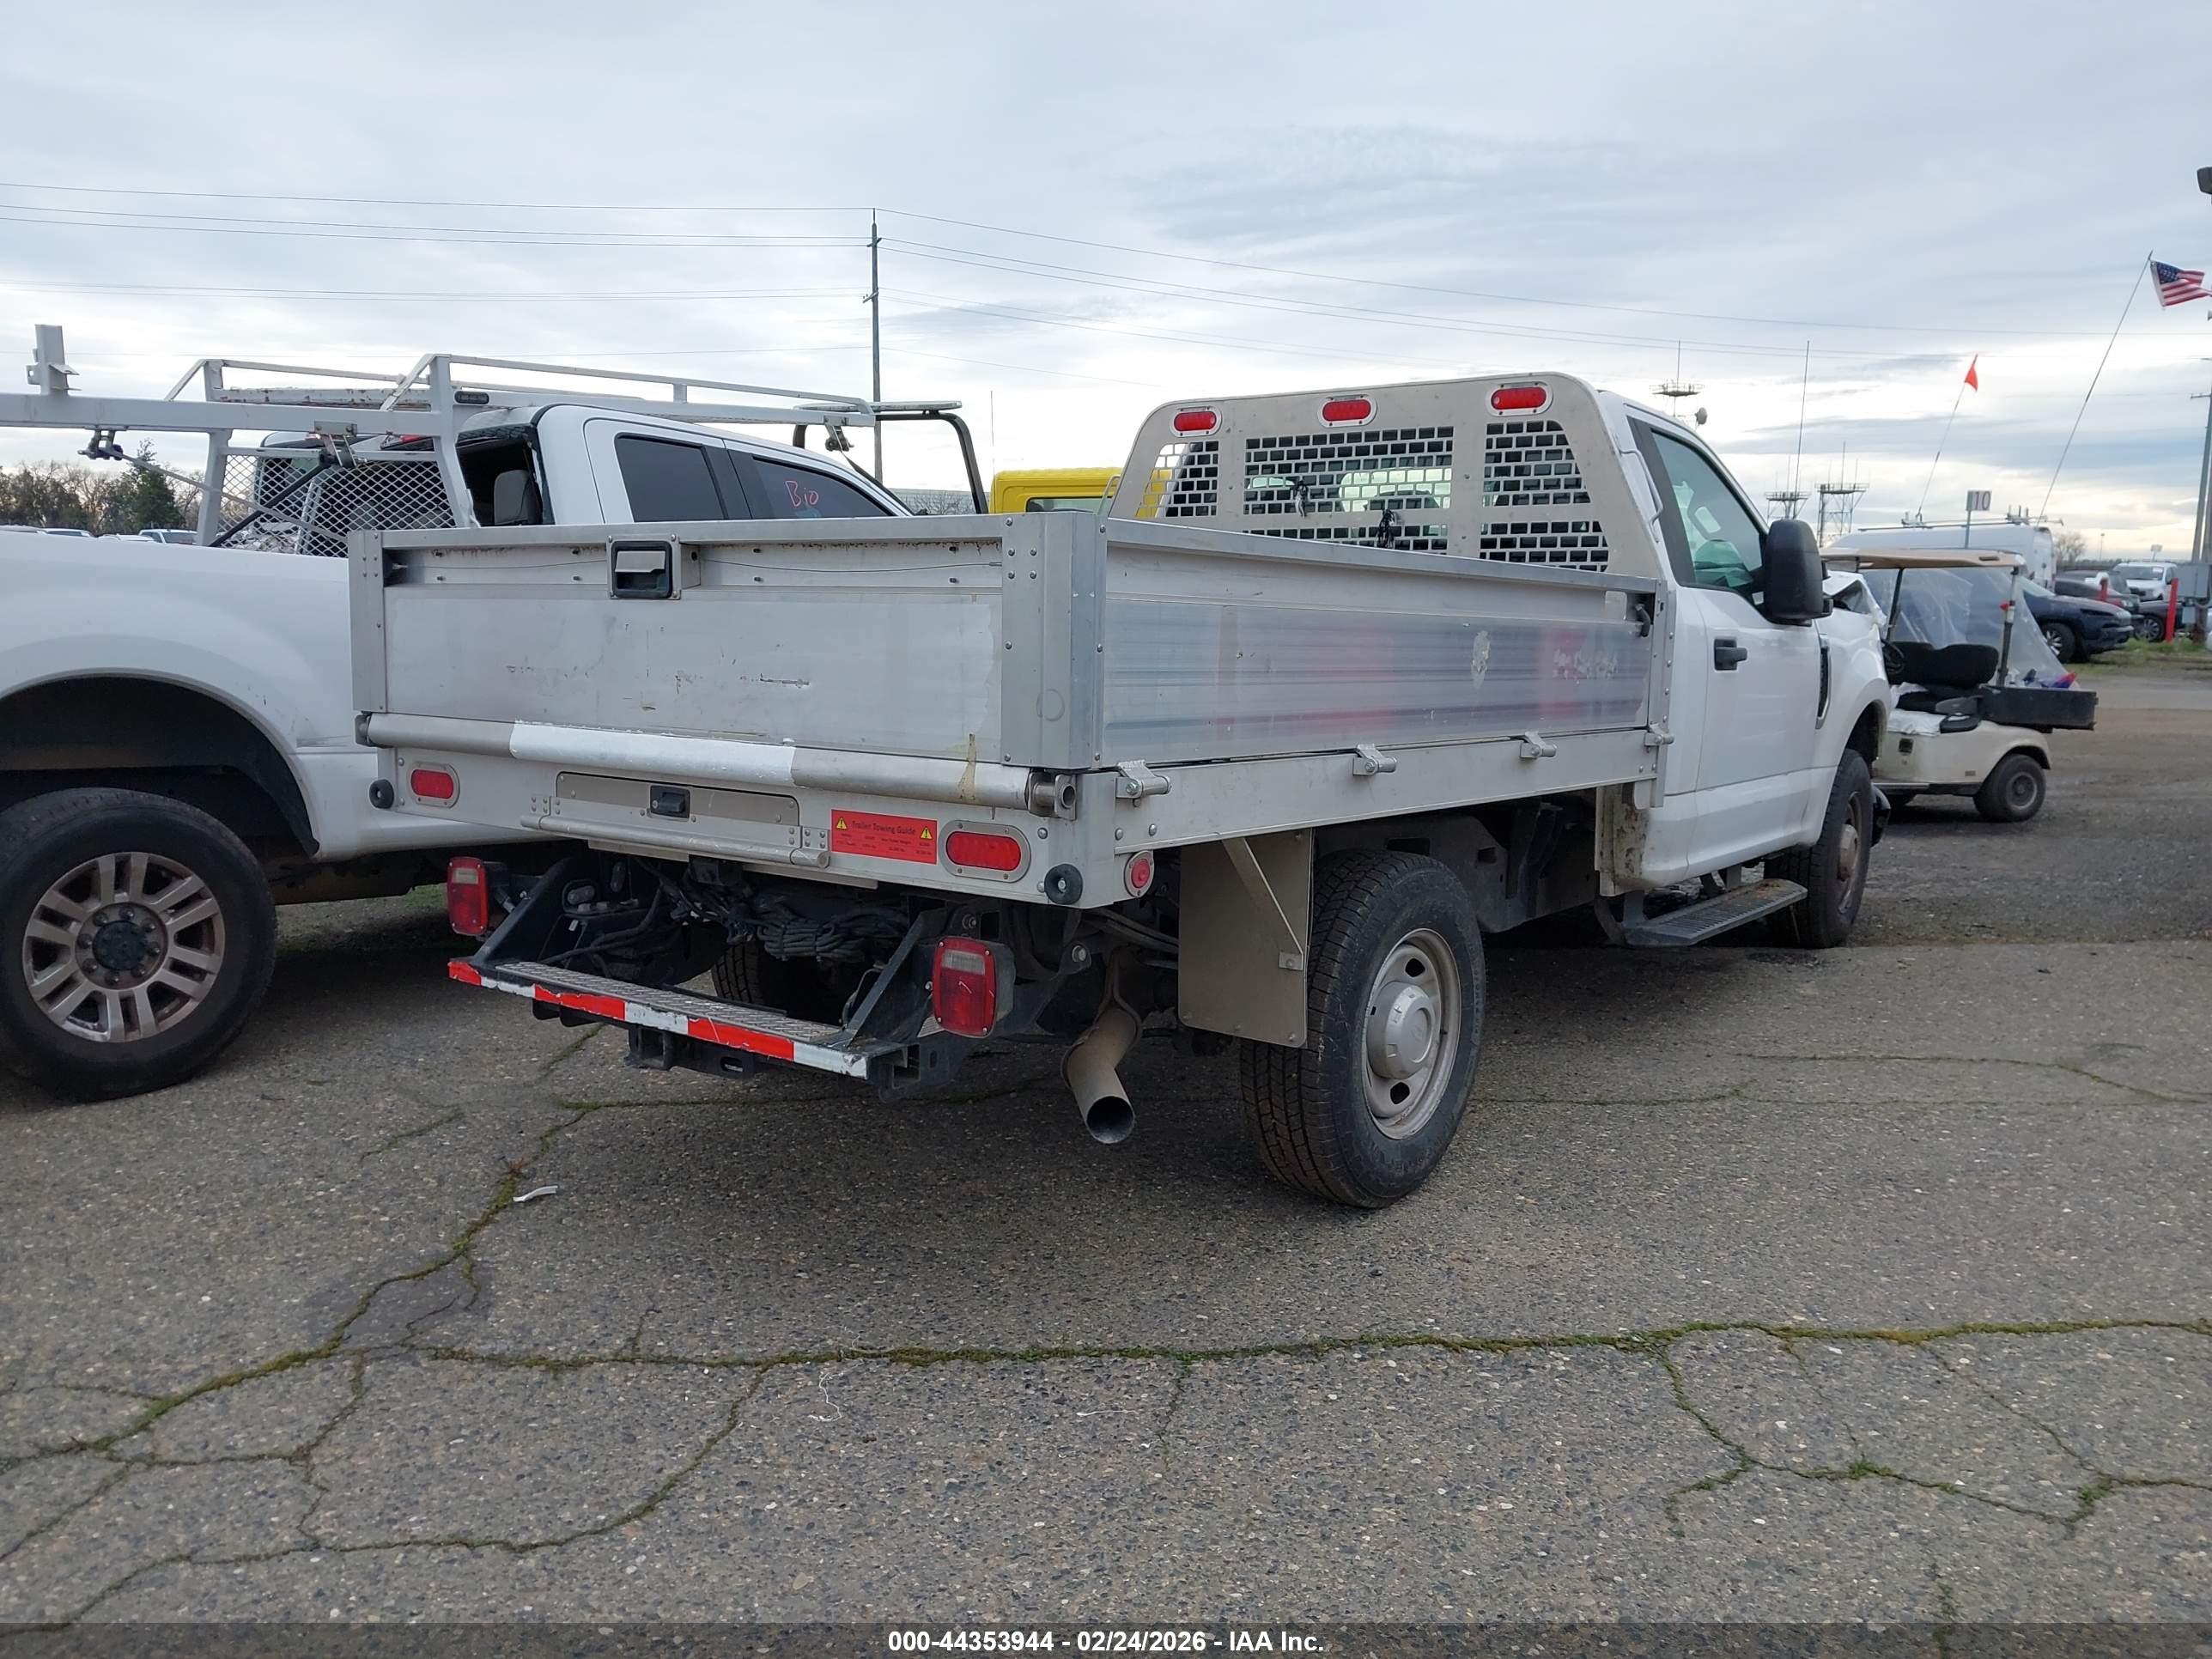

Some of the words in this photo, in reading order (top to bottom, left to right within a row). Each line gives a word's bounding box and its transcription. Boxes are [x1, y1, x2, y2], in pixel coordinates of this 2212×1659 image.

[784, 480, 819, 507] Bio
[1975, 490, 1991, 511] 10
[851, 819, 872, 830] Trailer
[872, 823, 896, 835] Towing
[896, 826, 916, 836] Guide
